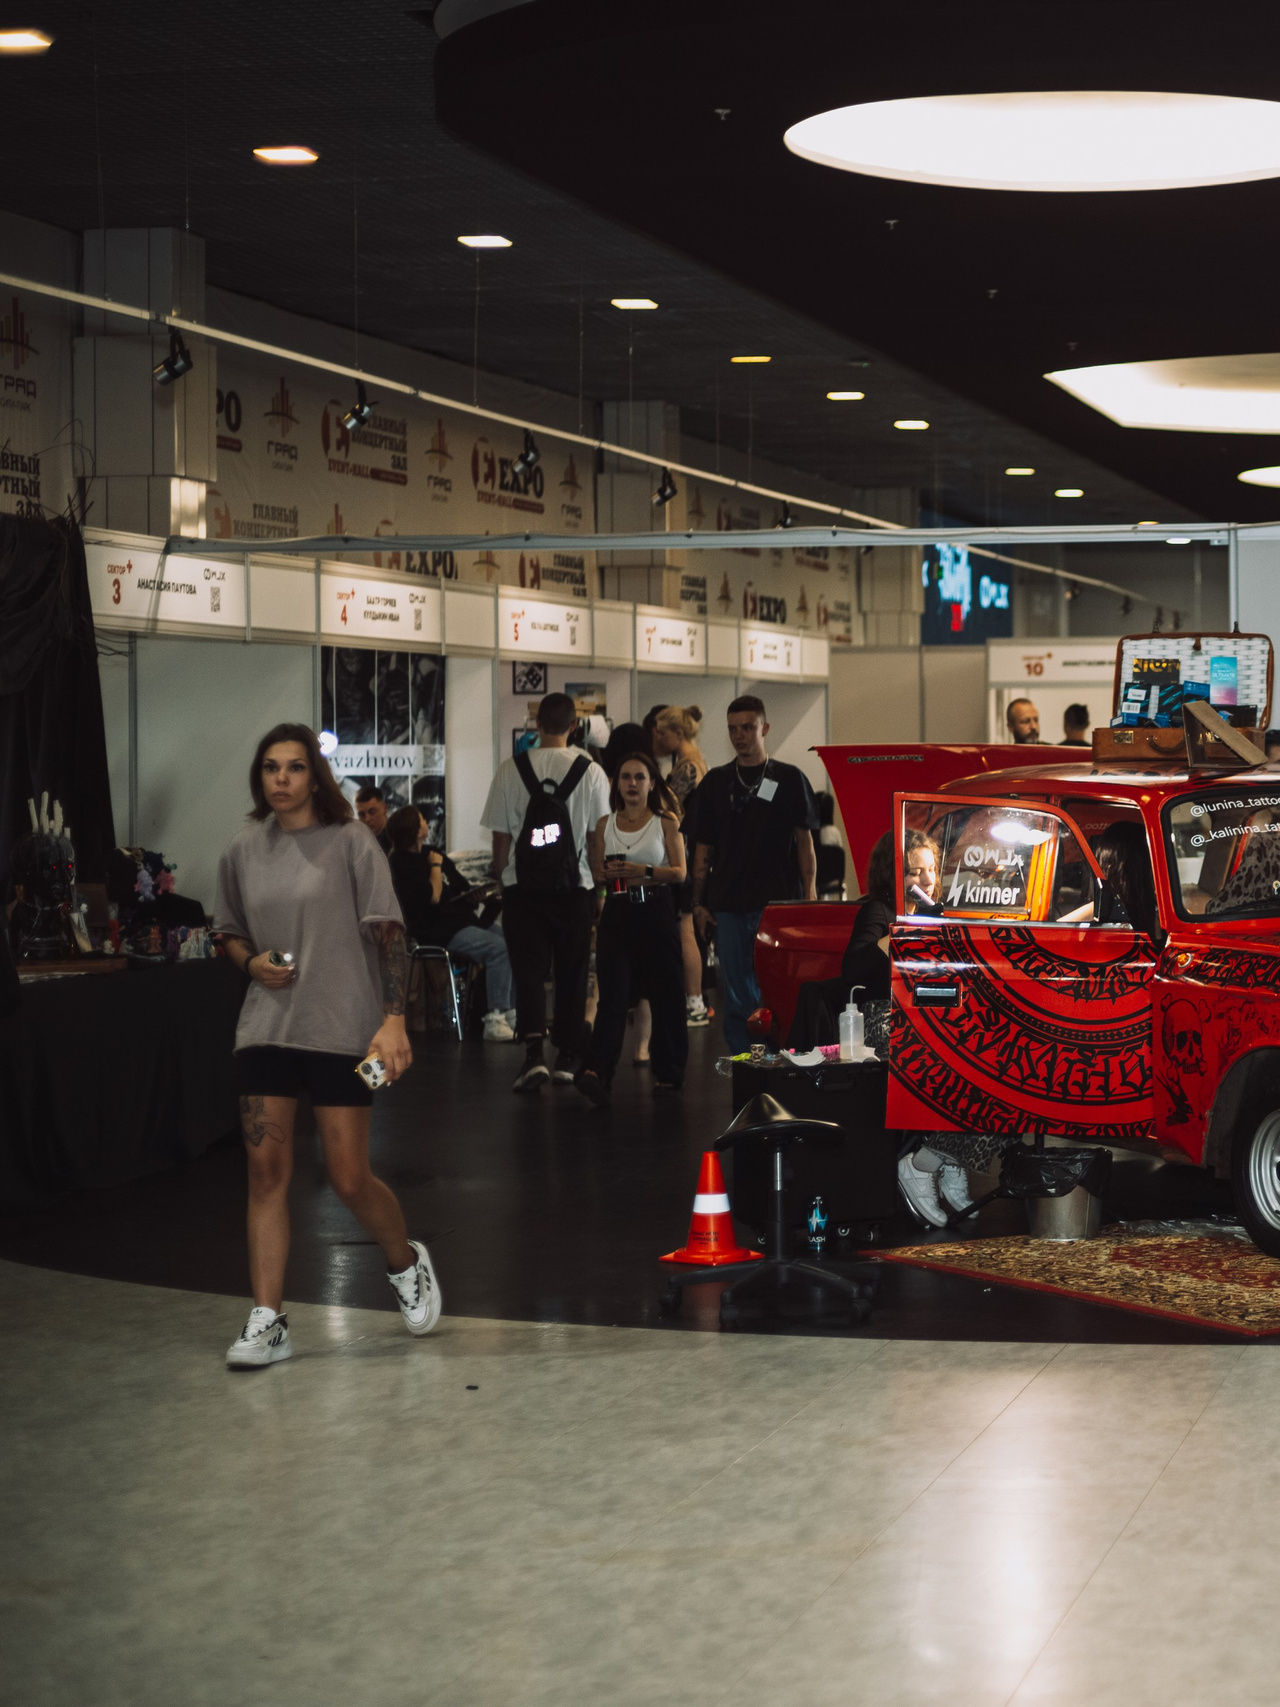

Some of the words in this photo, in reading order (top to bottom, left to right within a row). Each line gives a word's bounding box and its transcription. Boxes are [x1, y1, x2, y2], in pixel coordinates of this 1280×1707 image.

[0, 374, 36, 399] РАД
[0, 475, 40, 498] ТНЫЙ
[112, 578, 121, 605] 3
[136, 578, 171, 592] АНАСТАСИЯ
[171, 581, 197, 595] ПАУТОВА
[341, 604, 348, 626] 4
[514, 623, 519, 642] 5
[1025, 662, 1044, 676] 10
